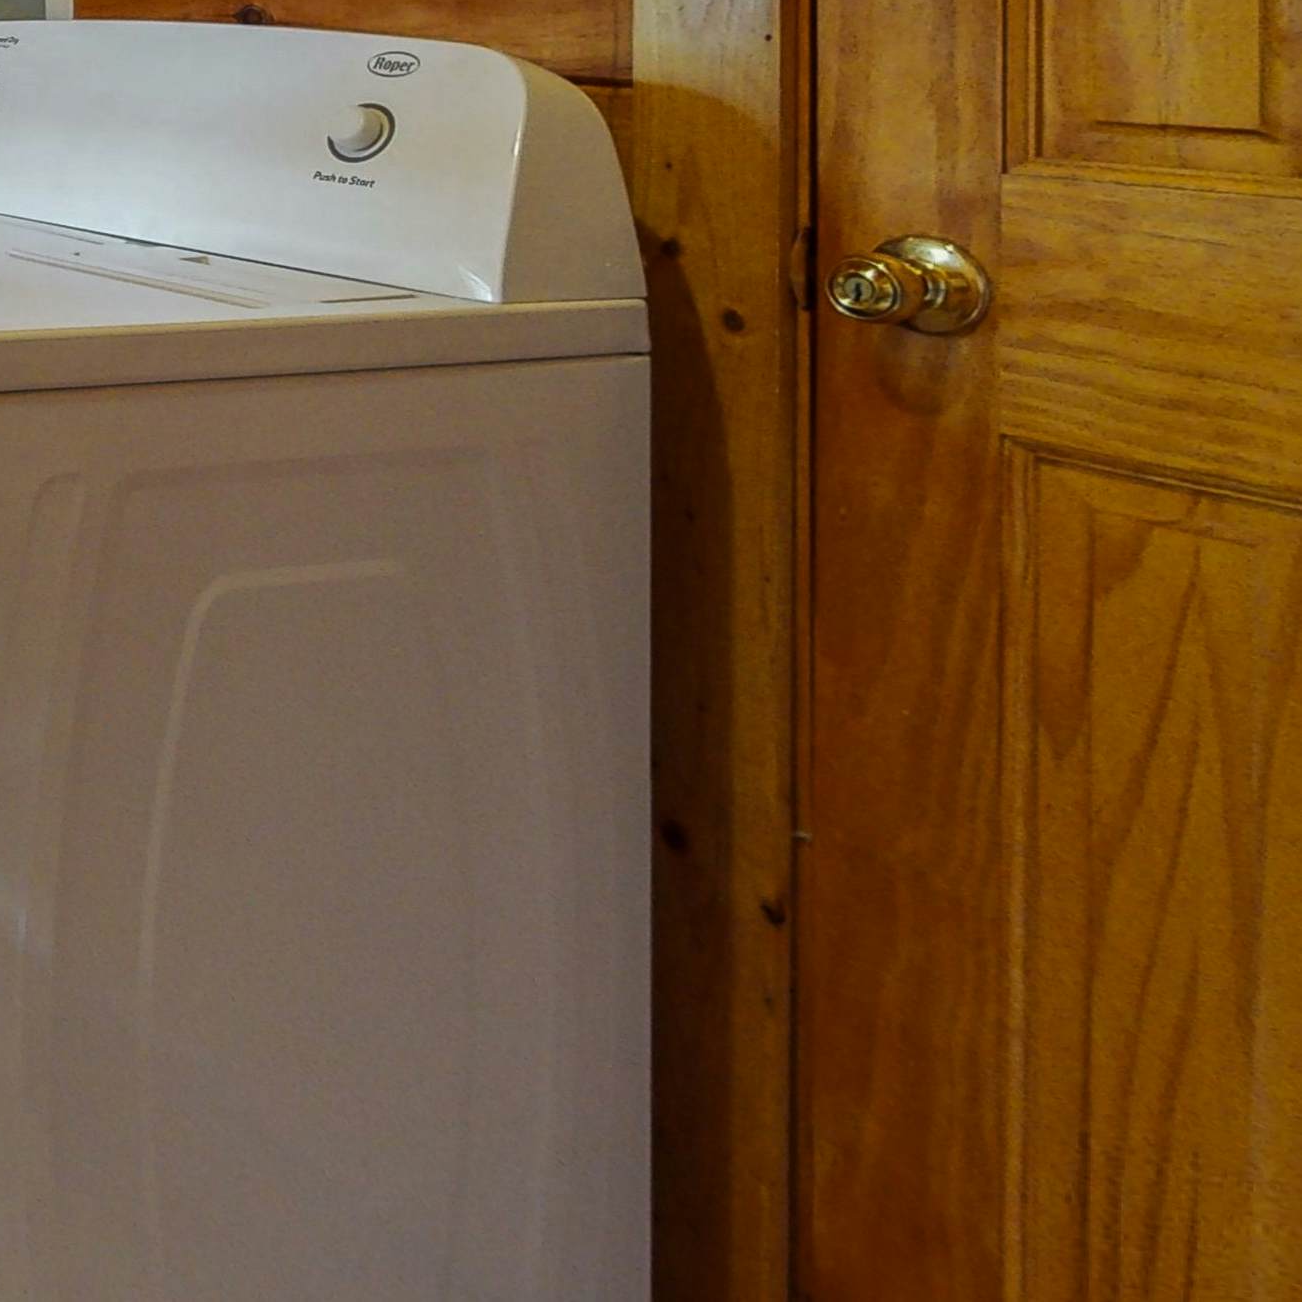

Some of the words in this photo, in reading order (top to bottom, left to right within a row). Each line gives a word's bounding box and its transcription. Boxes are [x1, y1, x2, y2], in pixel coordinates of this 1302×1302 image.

[372, 56, 416, 73] Roper
[312, 170, 336, 183] Push
[337, 175, 348, 185] to
[348, 175, 376, 188] Start
